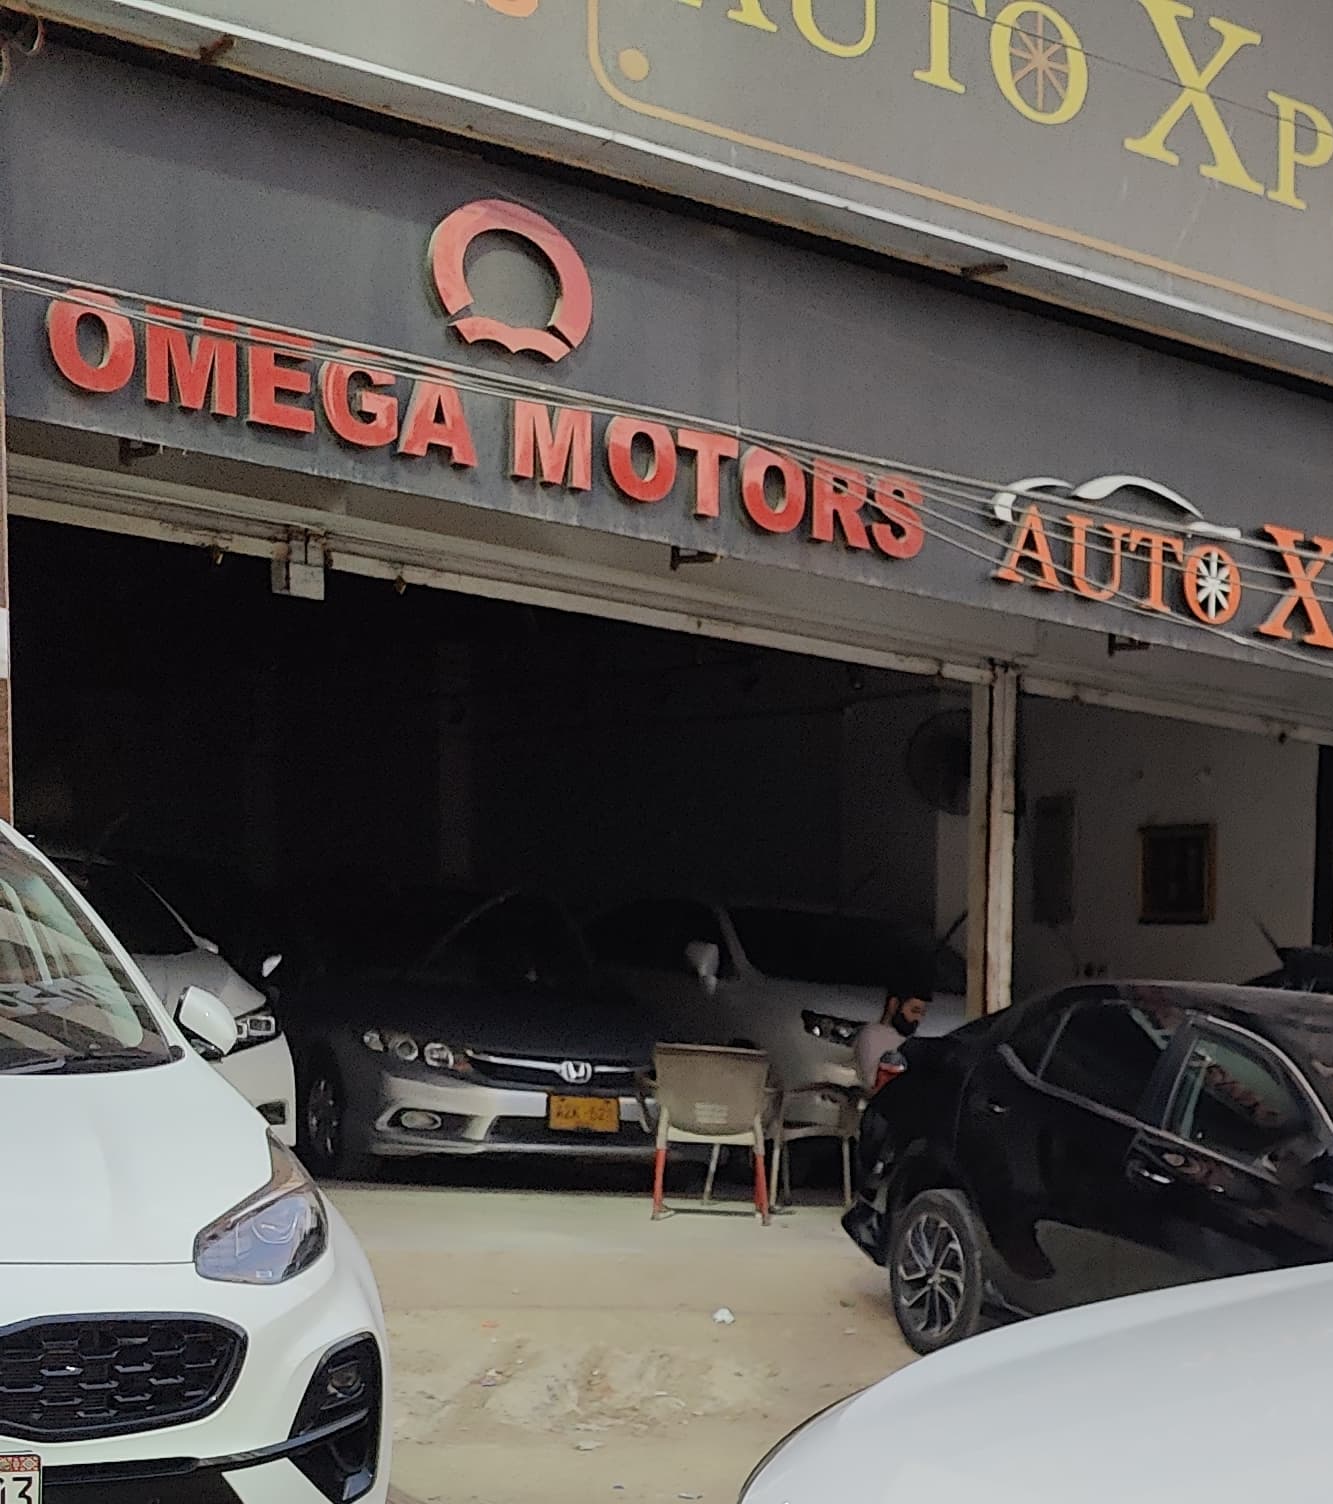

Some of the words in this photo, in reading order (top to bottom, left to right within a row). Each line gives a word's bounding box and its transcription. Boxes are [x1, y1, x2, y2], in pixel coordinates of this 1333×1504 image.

[676, 0, 1087, 125] TO
[45, 288, 478, 468] OMEGA
[511, 400, 925, 559] MOTORS
[991, 504, 1241, 625] AUTO
